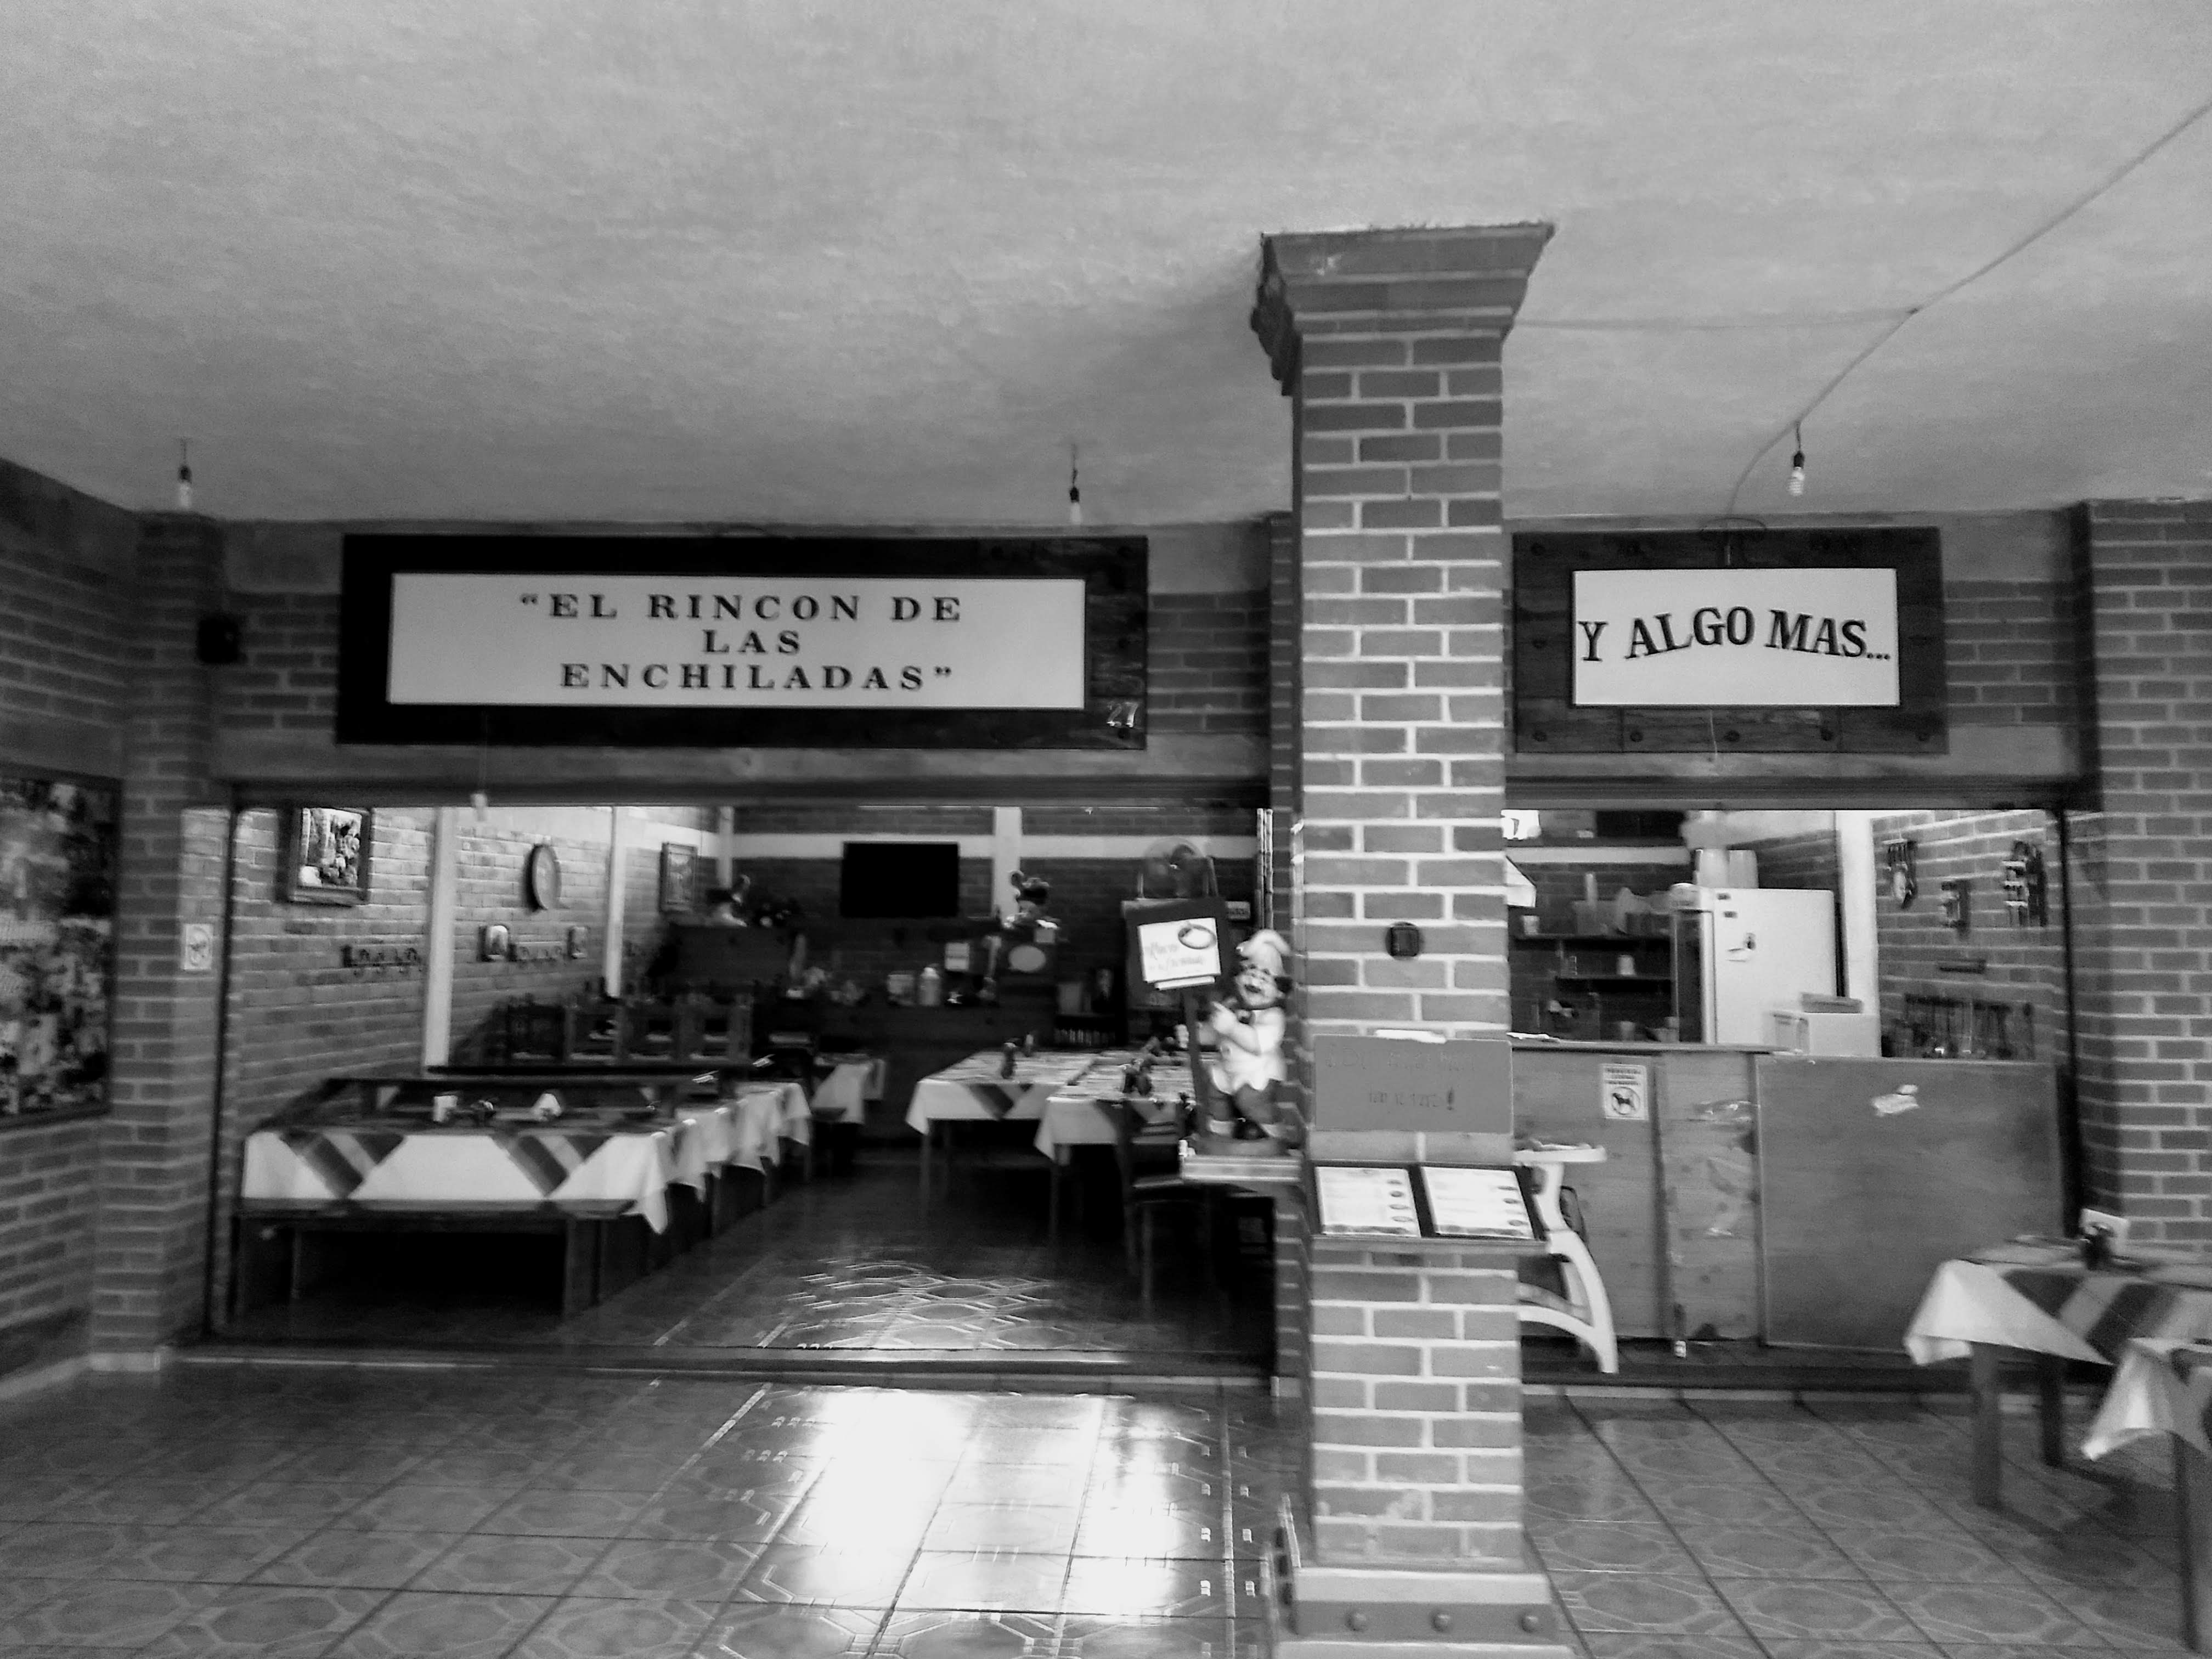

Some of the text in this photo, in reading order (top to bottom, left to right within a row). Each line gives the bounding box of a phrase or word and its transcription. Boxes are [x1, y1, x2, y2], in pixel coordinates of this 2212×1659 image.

[645, 593, 861, 622] RINCON
[889, 596, 961, 622] DE
[702, 629, 800, 656] LAS
[1577, 606, 1891, 662] Y ALGO MAS...
